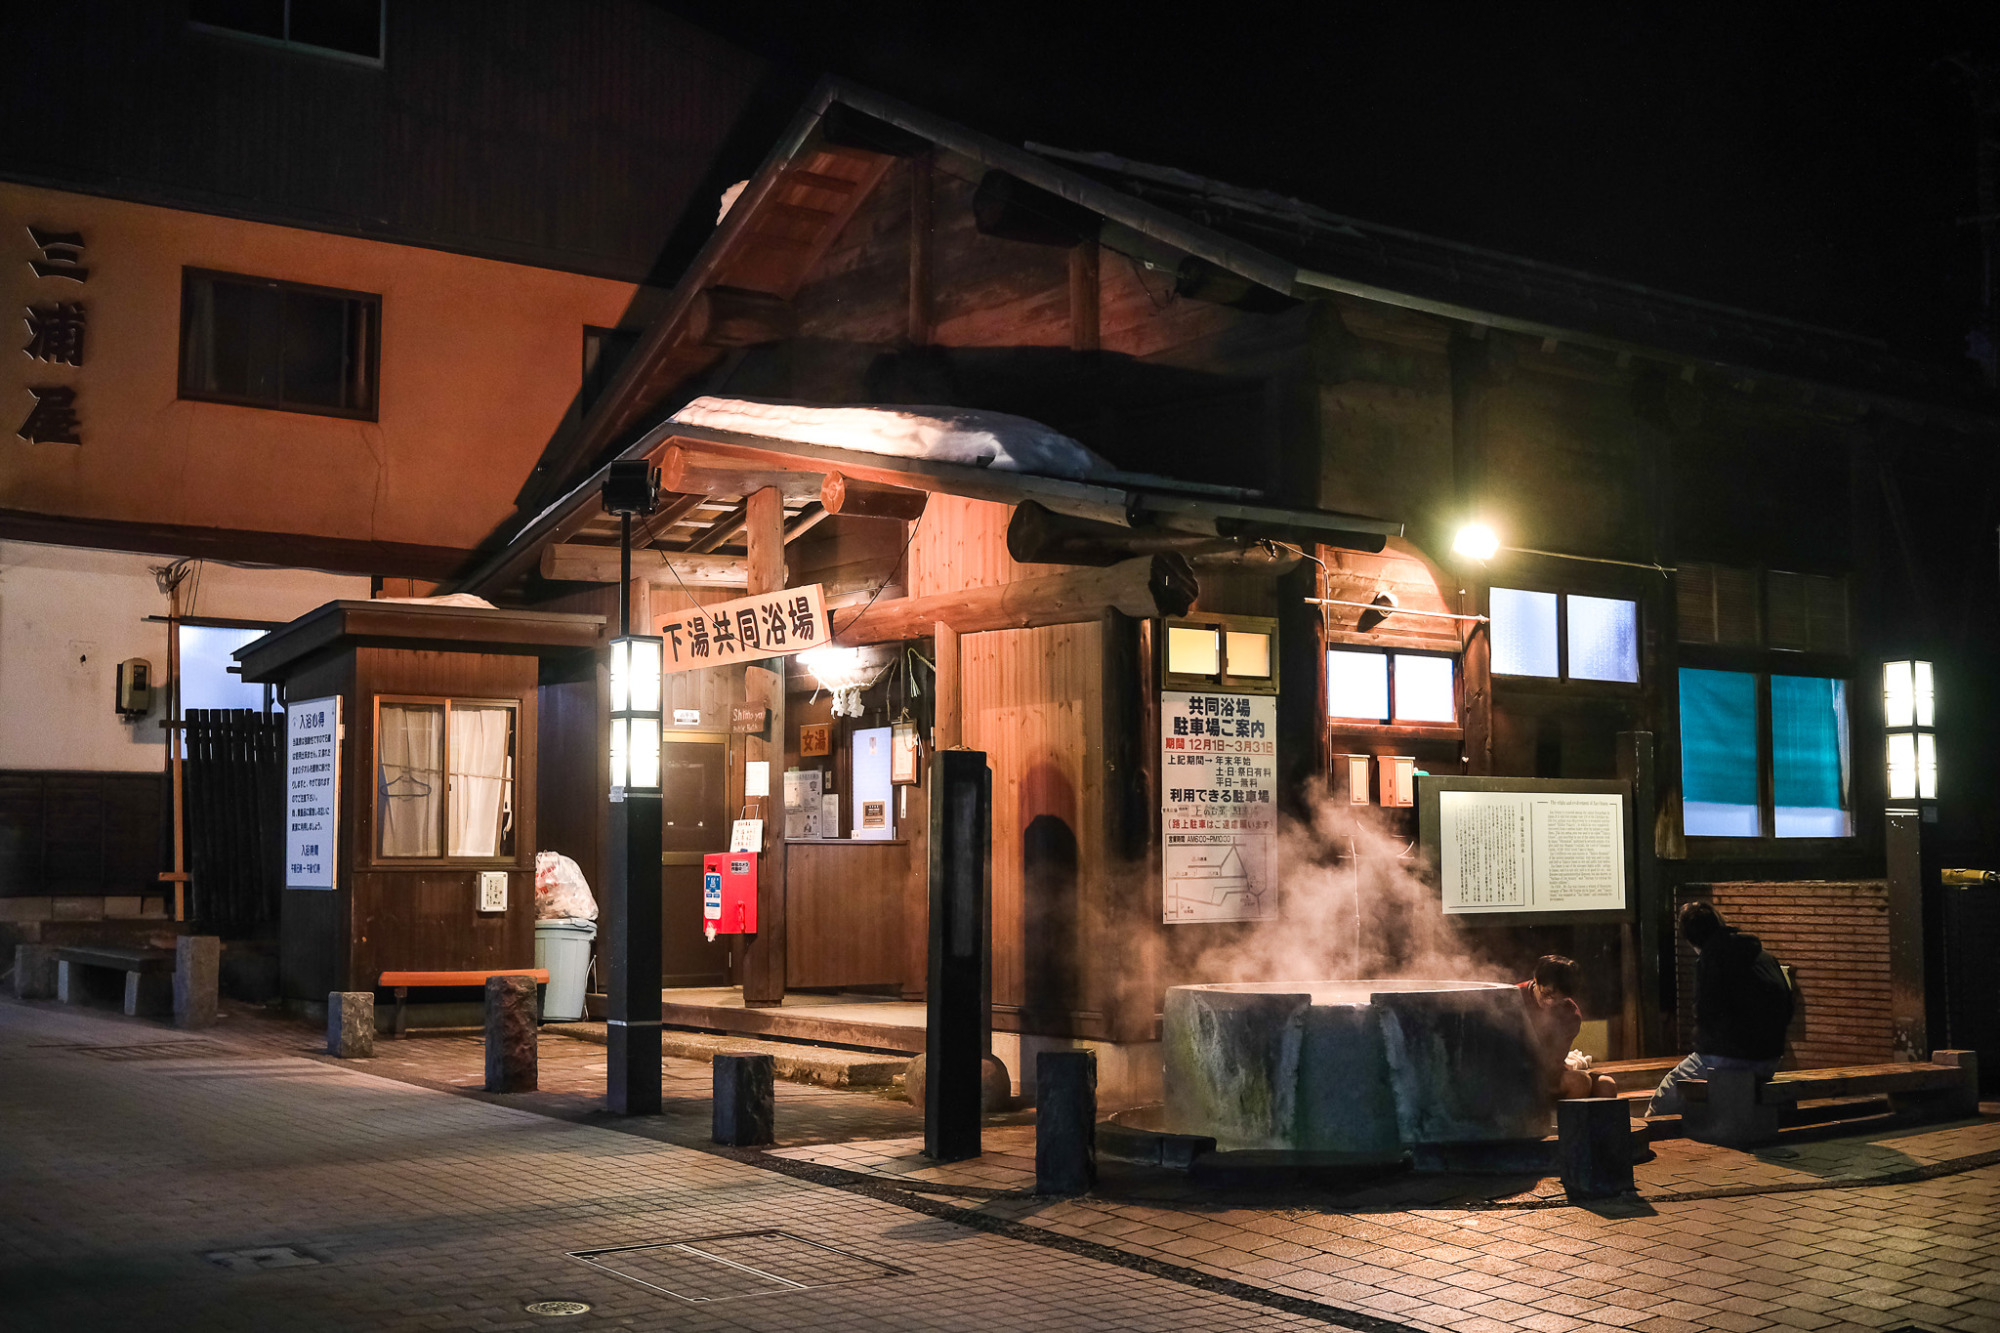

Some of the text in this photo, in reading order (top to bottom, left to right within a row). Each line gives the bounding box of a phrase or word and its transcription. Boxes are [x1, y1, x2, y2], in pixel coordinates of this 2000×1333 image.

[17, 226, 89, 446] 三浦屋
[662, 596, 814, 662] 下湯共同浴場
[1188, 696, 1251, 717] 共同浴場
[299, 712, 325, 729] 入浴心得
[1173, 717, 1265, 738] 駐車場ご案内
[802, 729, 826, 752] 女湯
[1165, 737, 1185, 749] 期間
[1215, 756, 1251, 766] 年末年始
[1170, 788, 1270, 803] 利用できる駐車場
